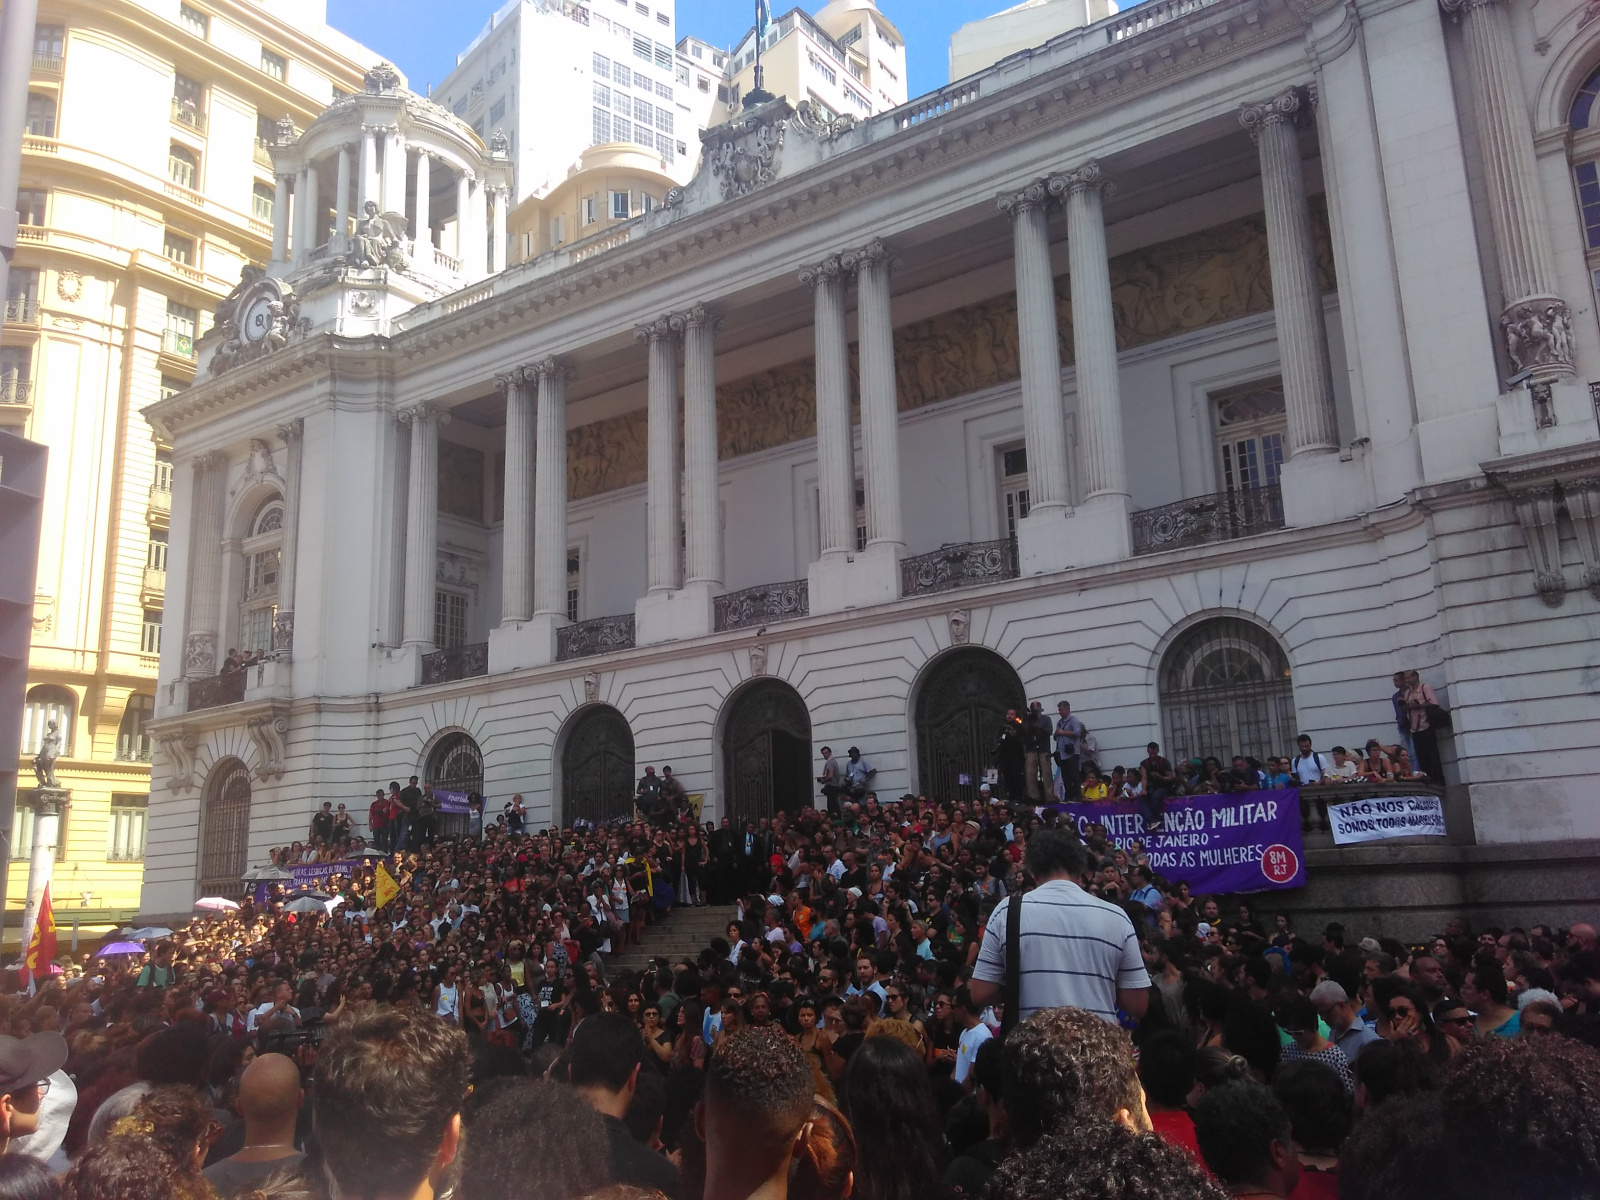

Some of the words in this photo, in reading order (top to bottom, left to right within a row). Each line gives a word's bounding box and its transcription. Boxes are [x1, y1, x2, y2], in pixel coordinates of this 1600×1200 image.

[1211, 800, 1278, 829] MILITAR
[1340, 803, 1372, 818] NÃO
[1376, 801, 1405, 813] NOS
[1338, 819, 1375, 834] SOMOS
[1115, 836, 1134, 849] RIO
[1139, 835, 1152, 848] DE
[1156, 833, 1209, 848] JANEIRO
[1179, 852, 1196, 867] AS
[1200, 844, 1263, 867] MULHERES
[1269, 851, 1287, 864] 8M
[1273, 864, 1288, 876] RJ
